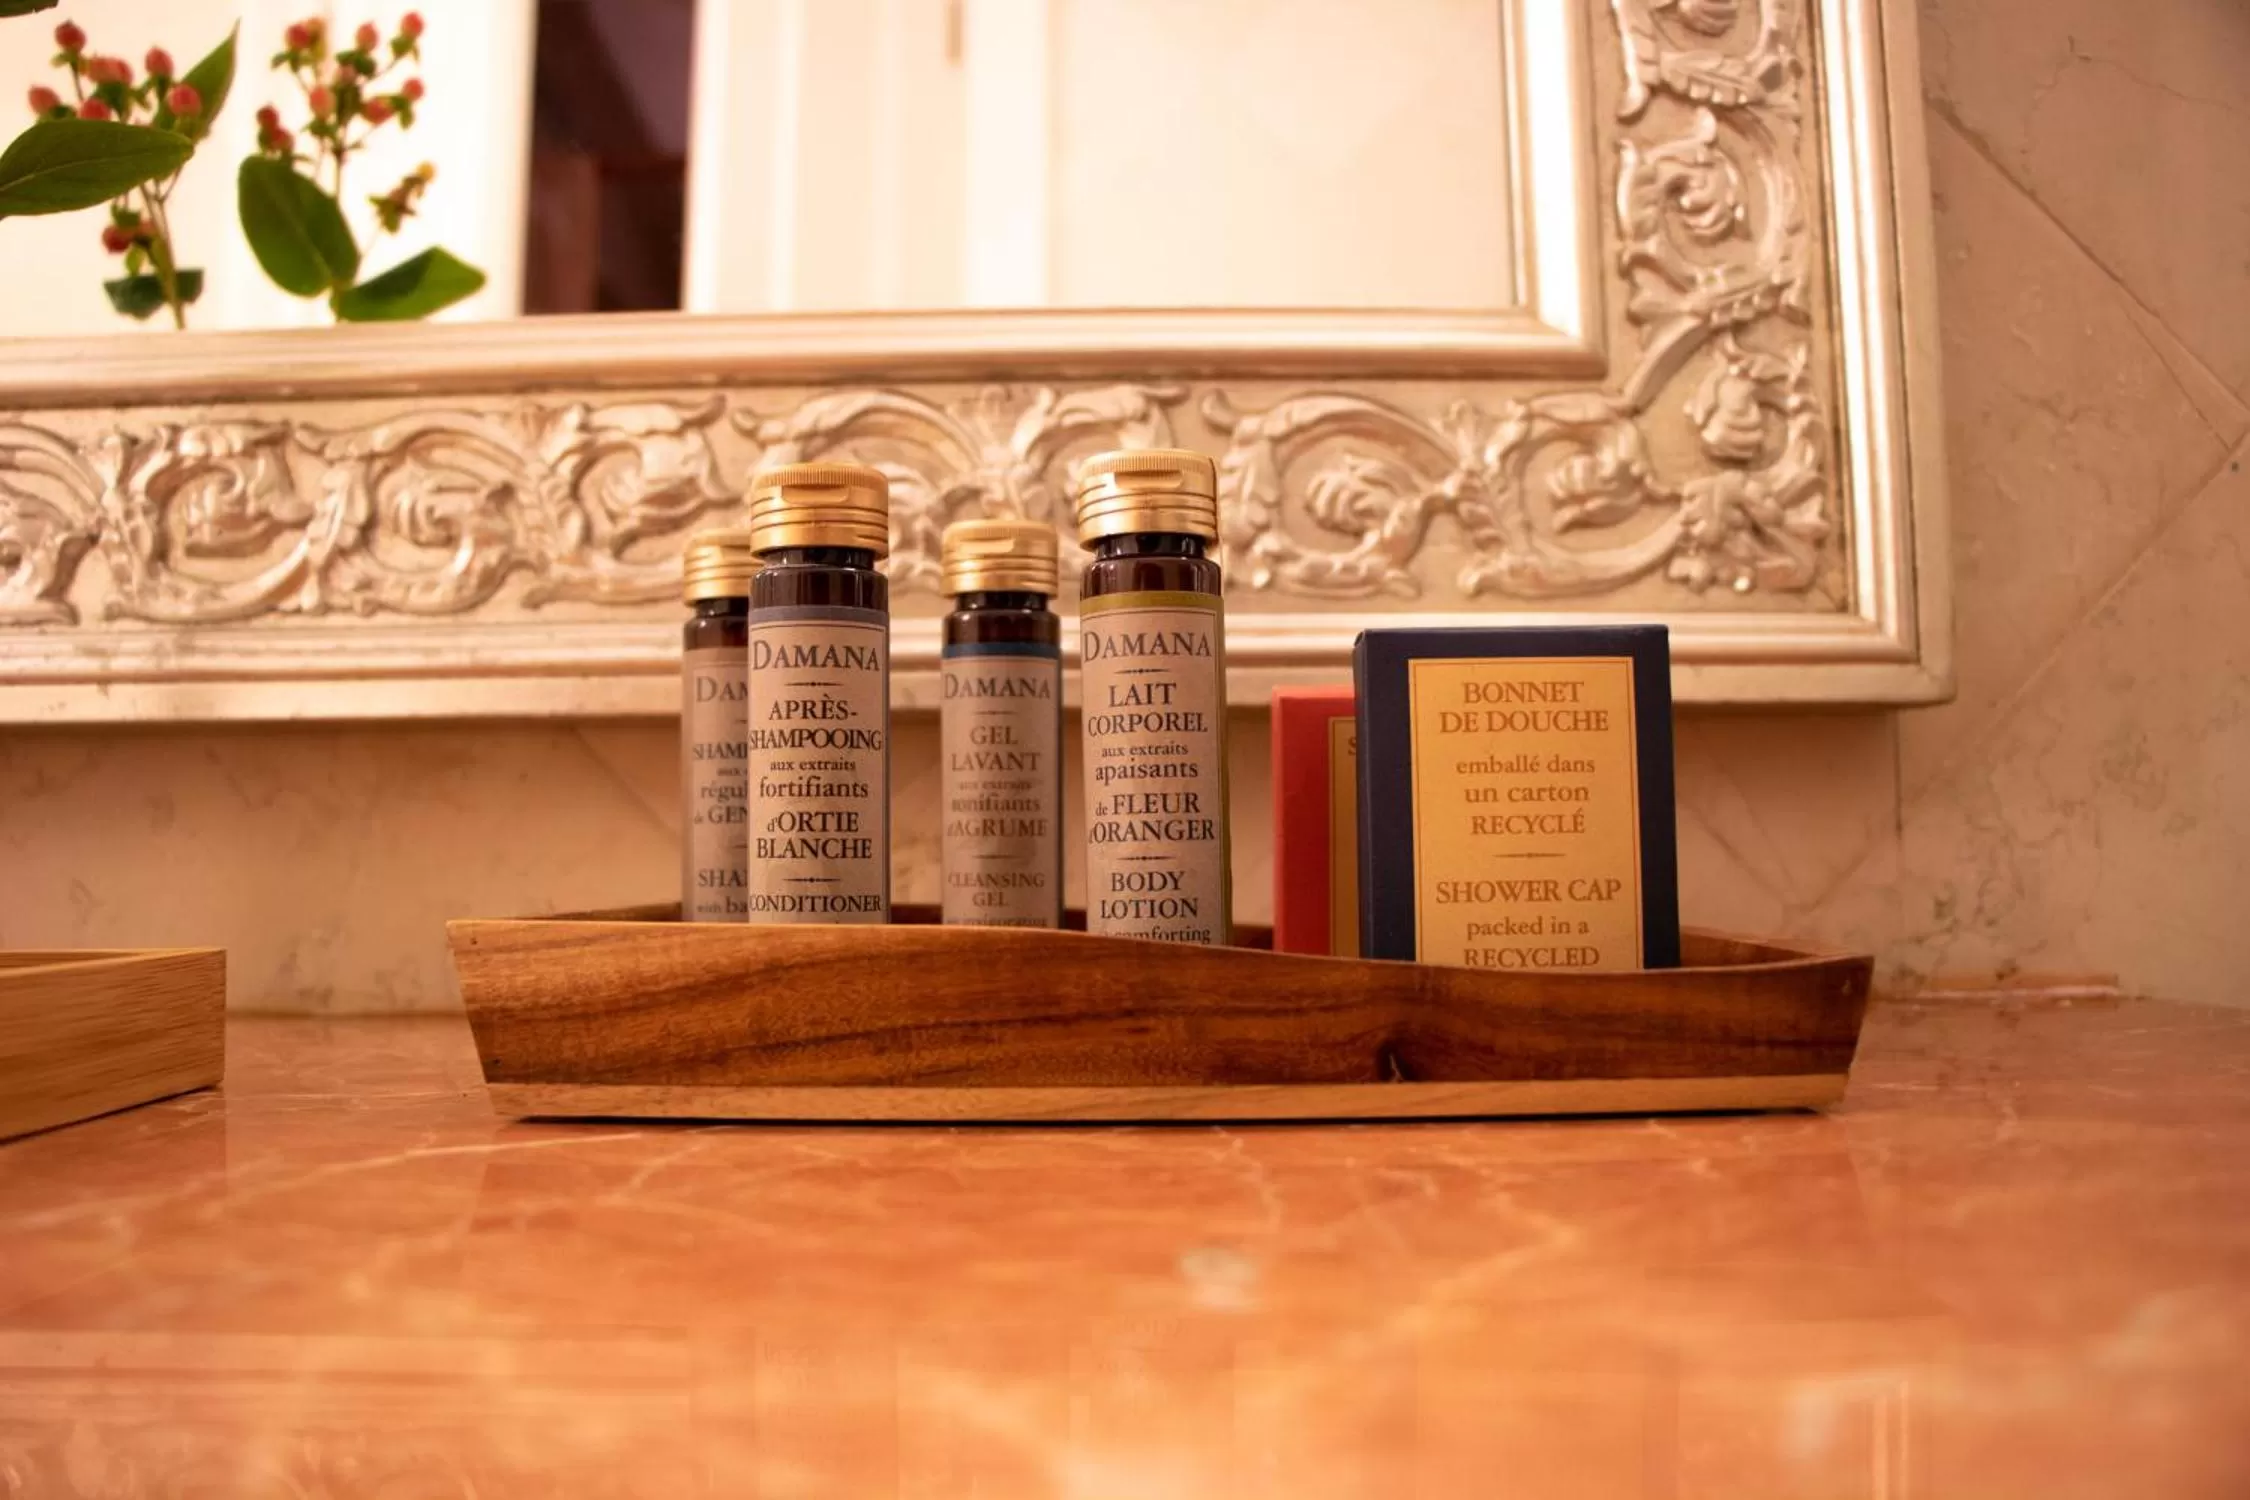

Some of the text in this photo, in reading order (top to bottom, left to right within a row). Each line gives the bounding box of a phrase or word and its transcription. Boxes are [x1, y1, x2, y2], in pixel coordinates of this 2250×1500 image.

[753, 639, 880, 672] DAMANA
[1084, 630, 1212, 662] DAMANA
[944, 673, 1050, 699] DAMANA
[1108, 682, 1177, 707] LAIT
[1462, 681, 1585, 704] BONNET
[768, 693, 858, 721] APRÈS-
[1087, 712, 1208, 737] CORPOREL
[1439, 709, 1610, 734] DE DOUCHE
[749, 728, 882, 751] SHAMPOOING
[969, 726, 1019, 746] GEL
[692, 742, 748, 760] SHAM
[1101, 742, 1189, 758] aux extraits
[770, 756, 856, 771] aux extraits
[951, 752, 1041, 772] LAVANT
[1095, 759, 1198, 785] apaisants
[1455, 754, 1596, 775] emballé dans
[759, 775, 869, 799] fortifiants
[1464, 784, 1590, 804] un carton
[1095, 792, 1201, 816] de FLEUR
[767, 811, 859, 833] d'ORTIE
[1470, 808, 1585, 835] RECYCLÉ
[756, 837, 872, 859] BLANCHE
[698, 868, 748, 888] SHA
[947, 871, 1046, 888] CLEANSING
[1110, 870, 1186, 892] BODY
[971, 891, 1010, 908] GEL
[1435, 878, 1622, 904] SHOWER CAP
[750, 894, 881, 913] CONDITIONER
[1101, 898, 1198, 919] LOTION
[1466, 917, 1590, 941] packed in a
[1463, 947, 1600, 969] RECYCLED
